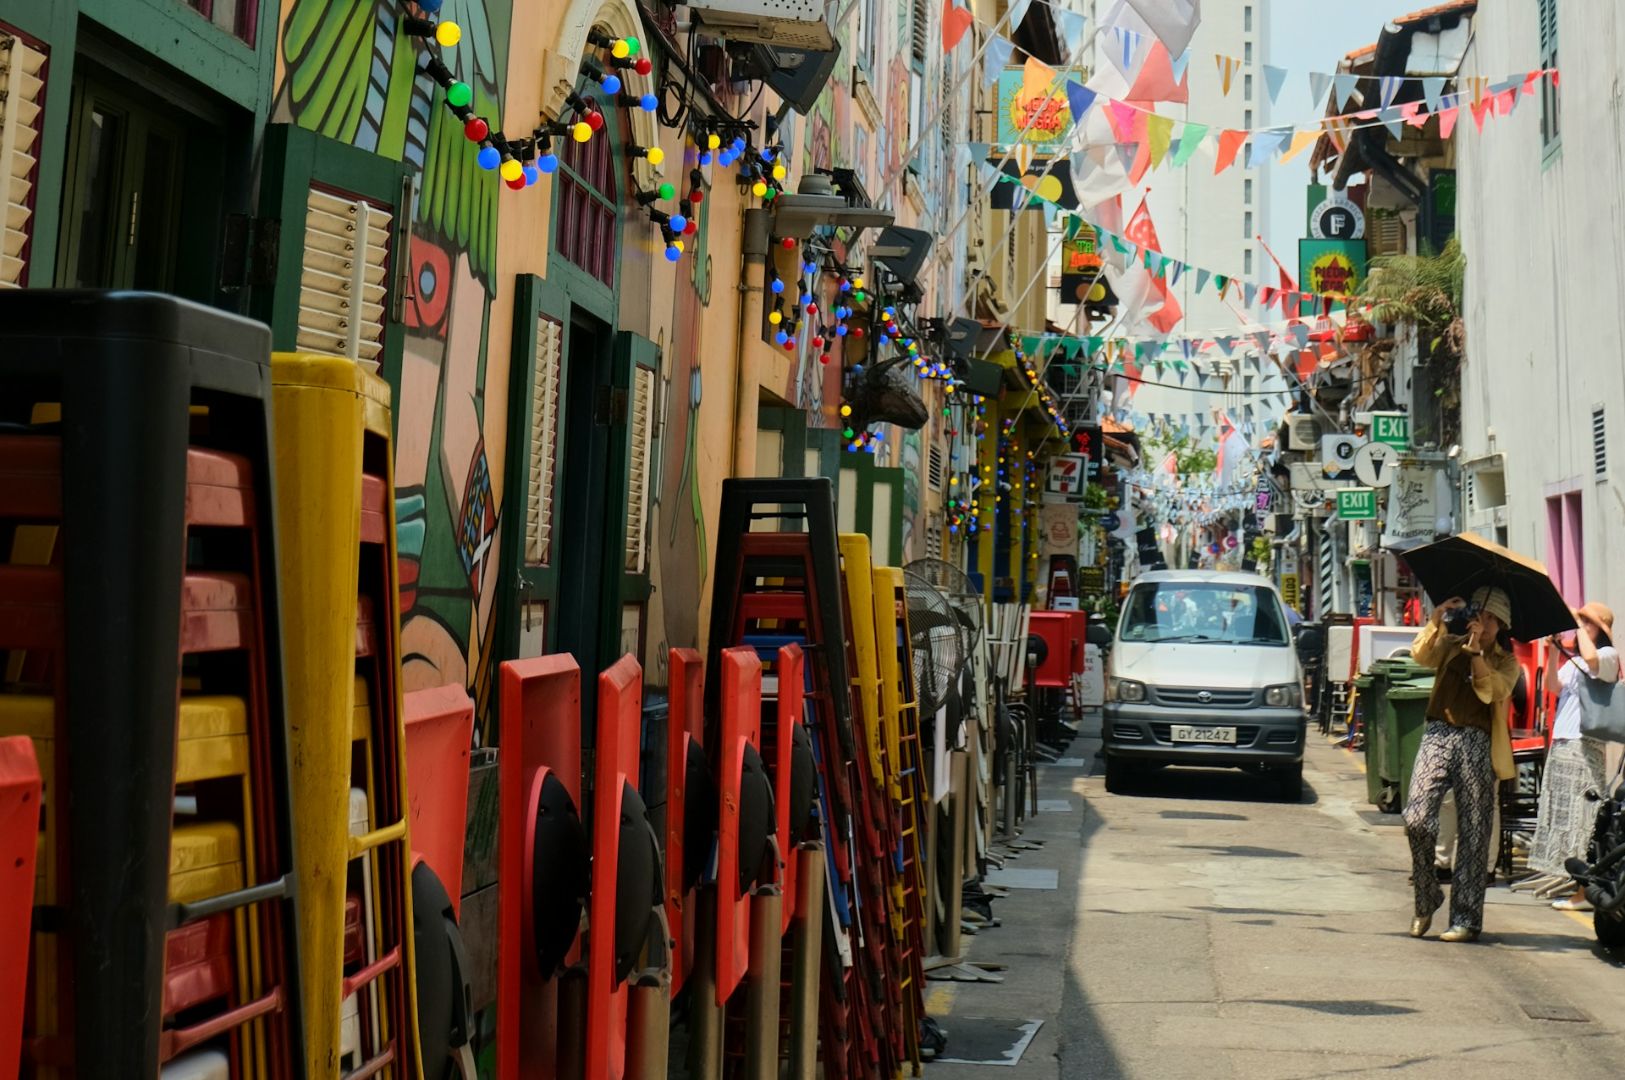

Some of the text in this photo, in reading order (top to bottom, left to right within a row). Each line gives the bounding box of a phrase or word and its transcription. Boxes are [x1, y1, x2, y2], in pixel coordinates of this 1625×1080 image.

[1330, 214, 1346, 235] F
[1314, 266, 1354, 279] PIEDRA
[1055, 460, 1077, 493] 7
[1342, 493, 1370, 508] EXIT
[1178, 730, 1230, 741] GY 2124 Z
